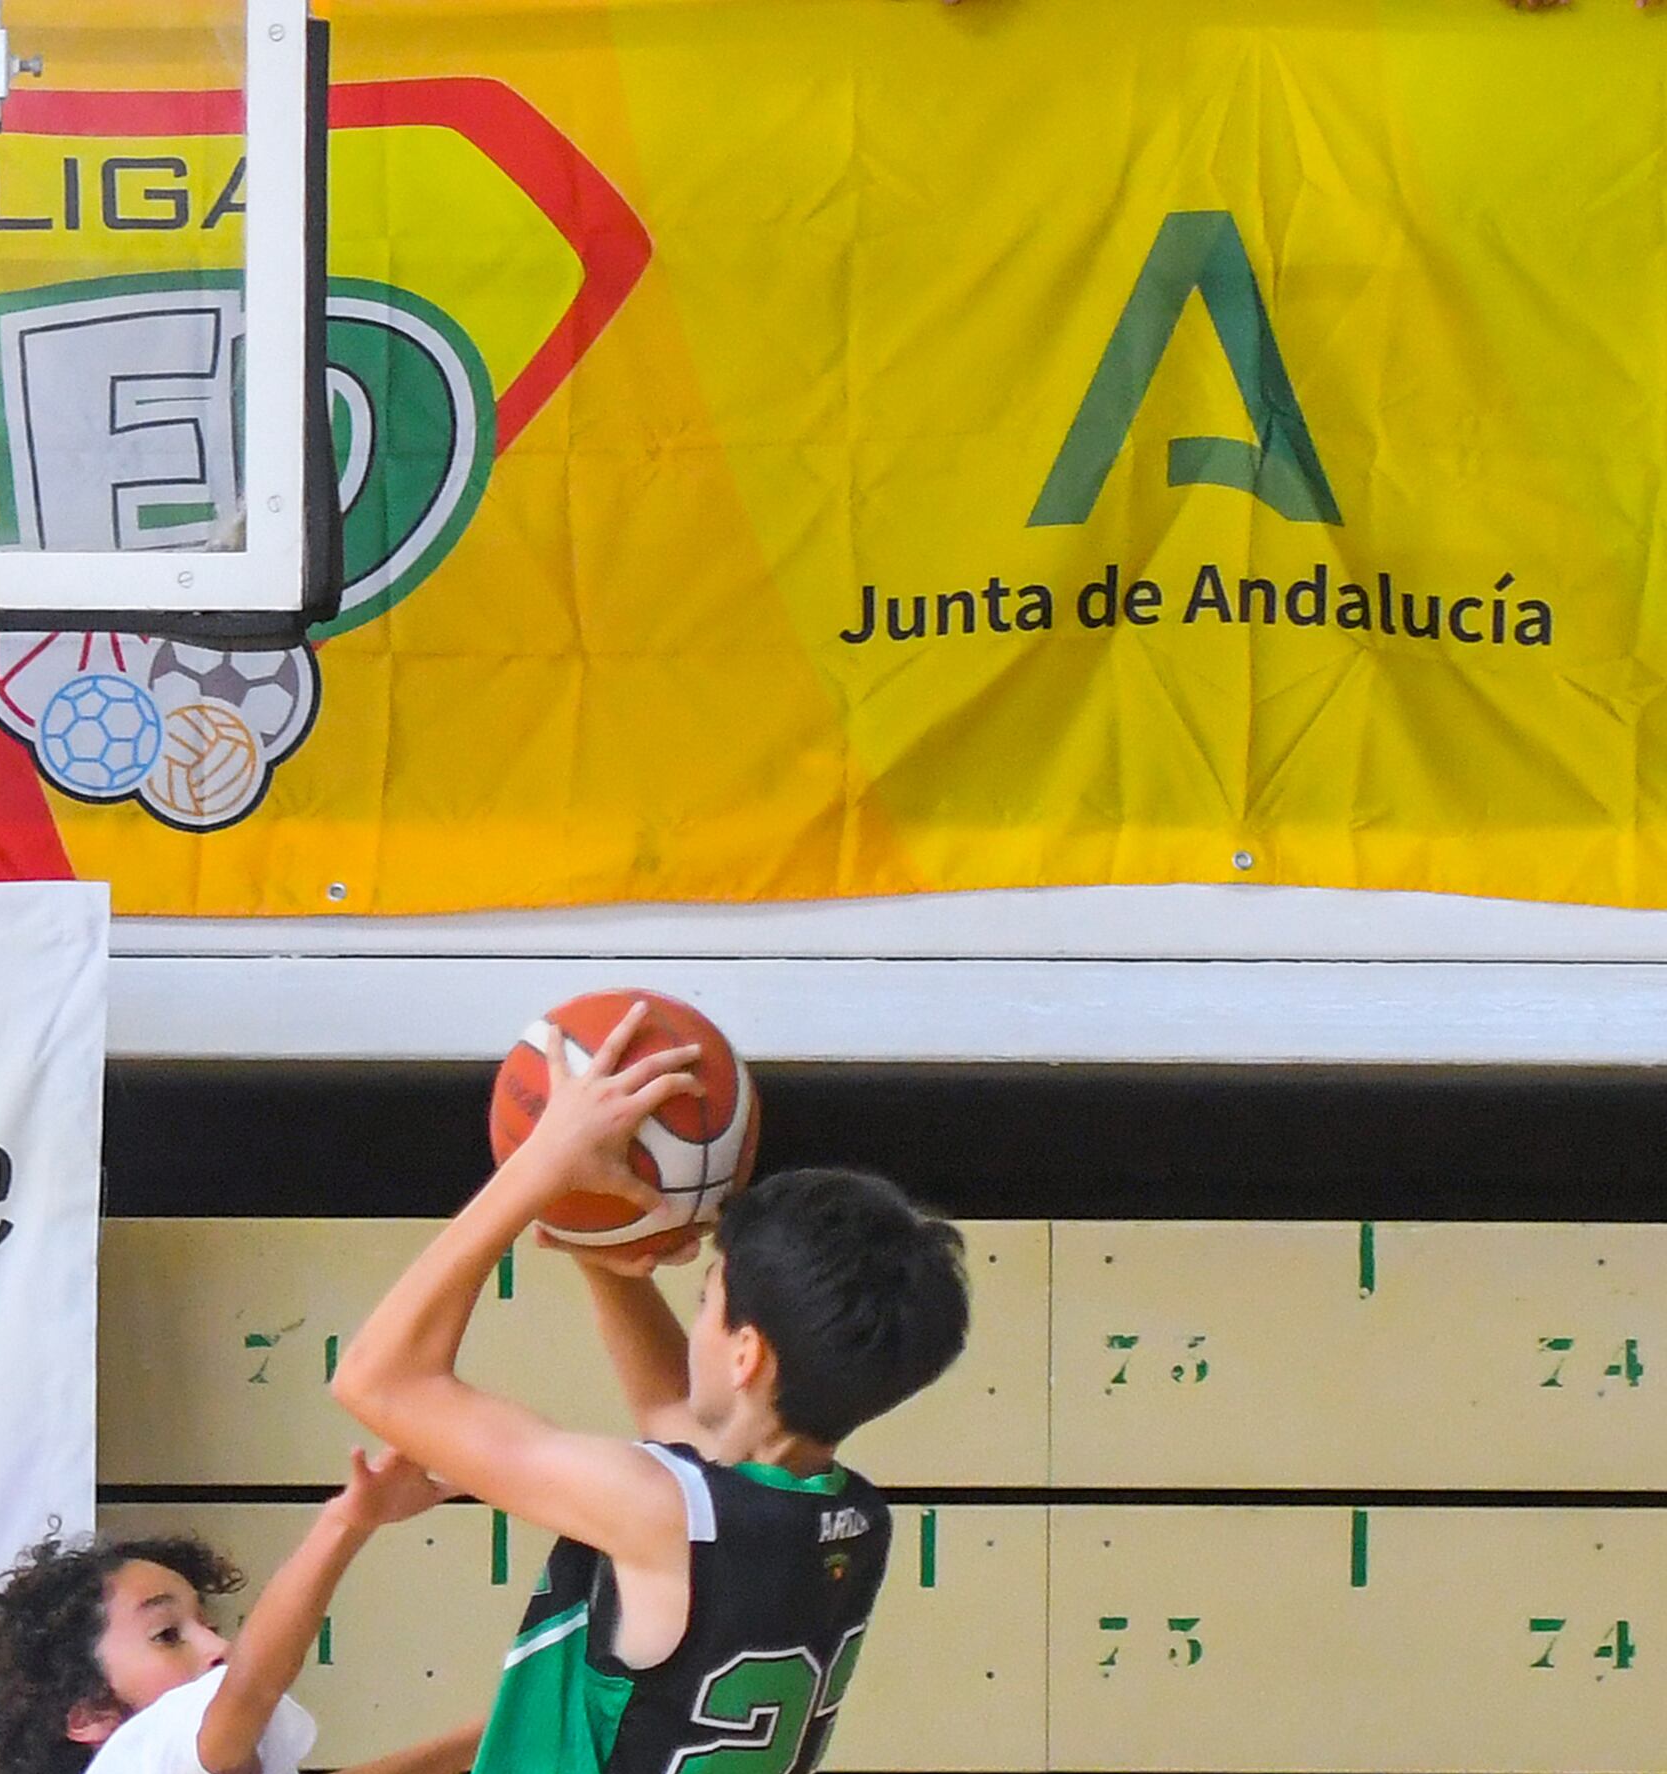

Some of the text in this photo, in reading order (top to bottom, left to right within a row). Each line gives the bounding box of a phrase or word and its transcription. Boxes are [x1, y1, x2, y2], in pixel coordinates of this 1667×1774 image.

[839, 563, 1551, 646] Junta de Andalucía
